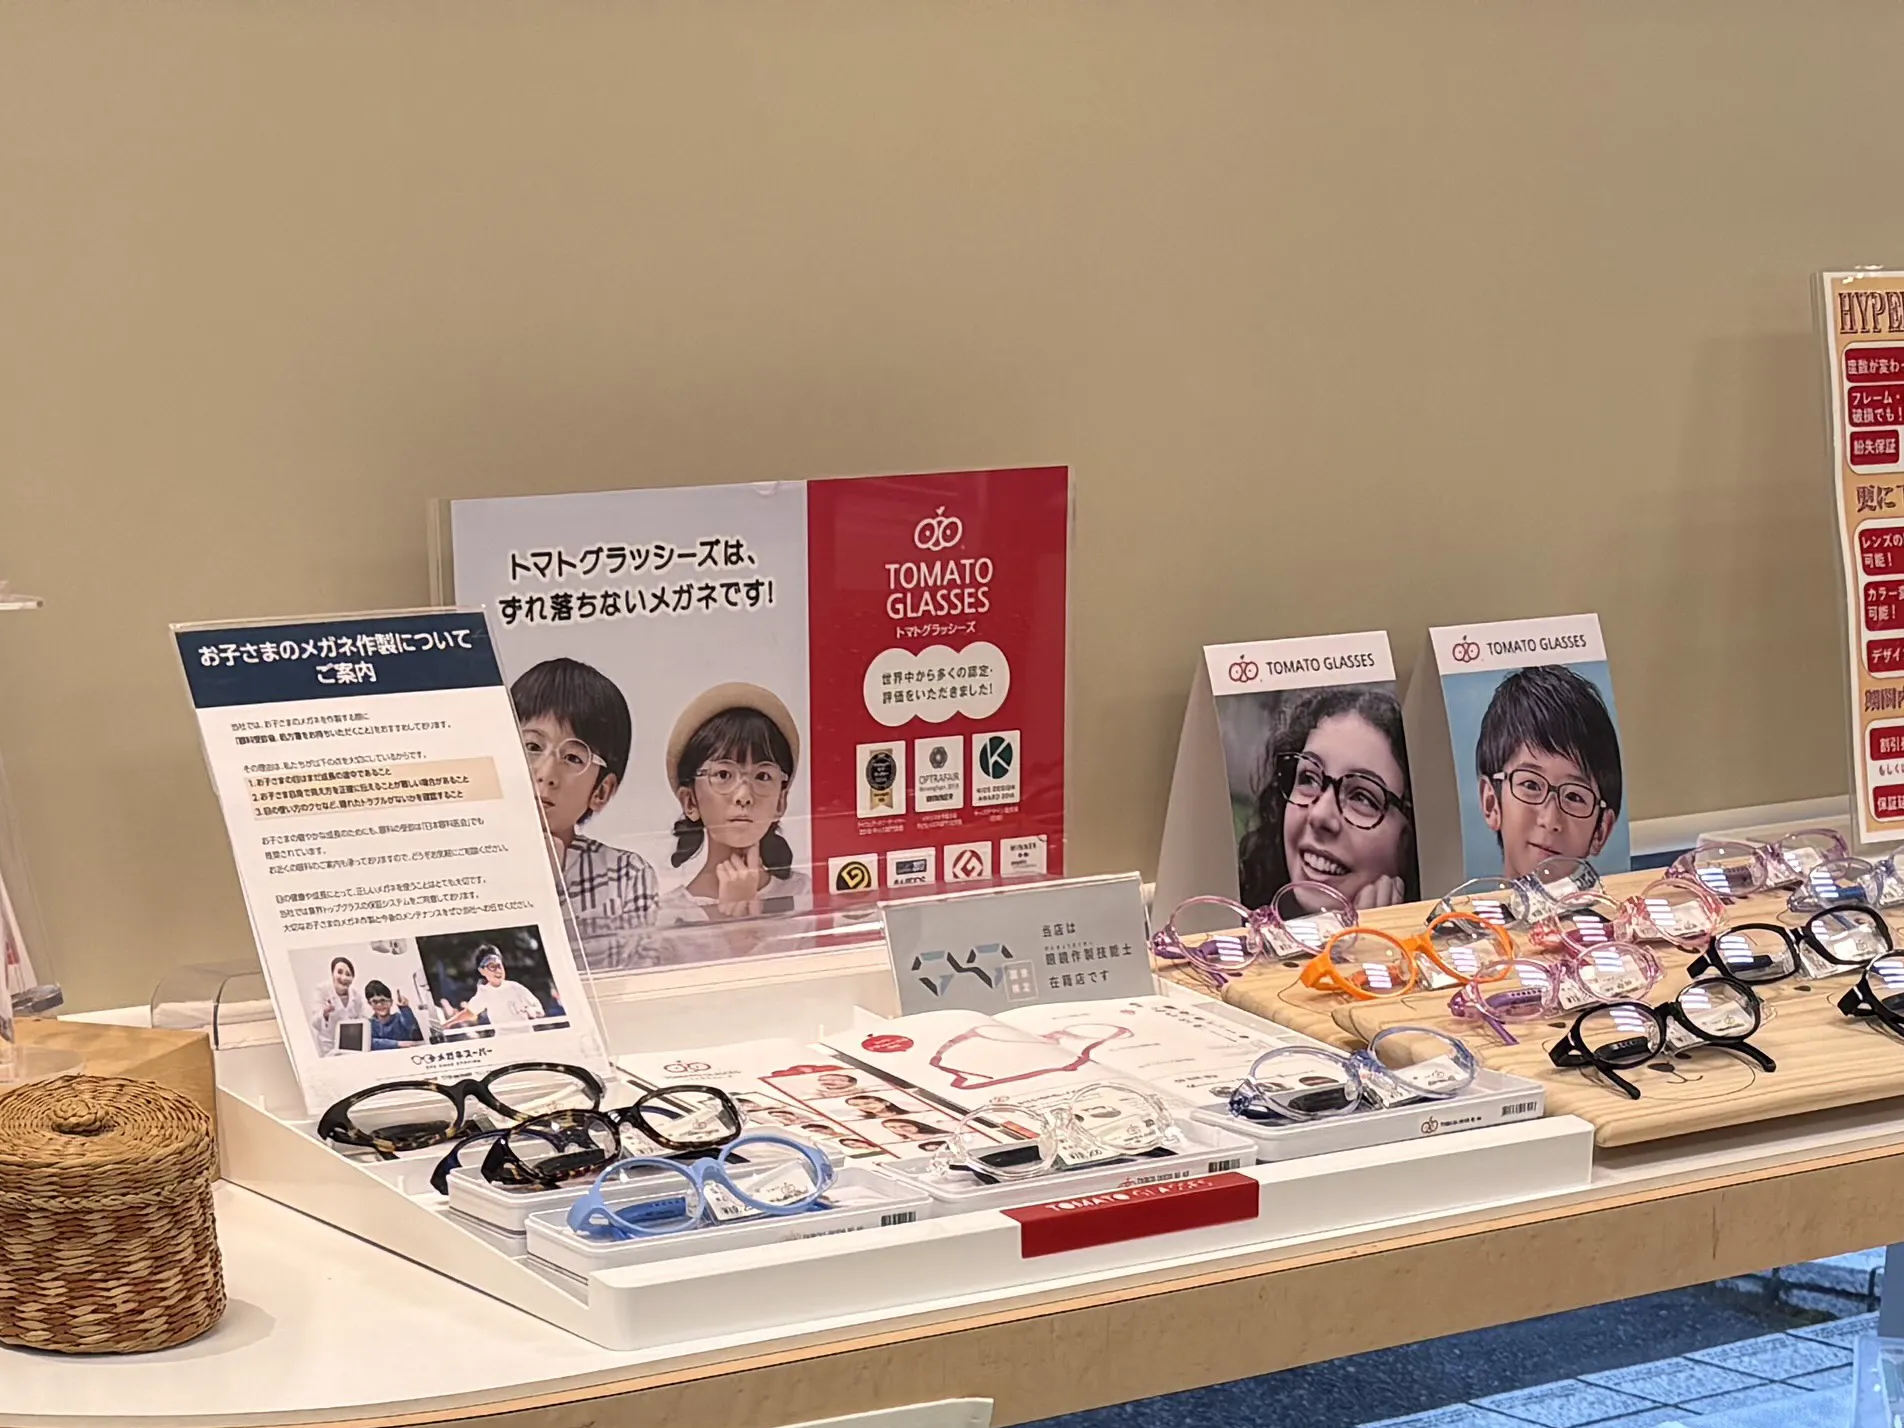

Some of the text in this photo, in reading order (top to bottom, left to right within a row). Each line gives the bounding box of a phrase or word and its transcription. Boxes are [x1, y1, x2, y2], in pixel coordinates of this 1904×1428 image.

[1852, 437, 1897, 456] 紛失保証
[510, 537, 757, 581] トマトグラッシーズは、
[884, 556, 994, 590] TOMATO
[498, 579, 774, 626] ずれ落ちないメガネです!
[886, 586, 991, 620] GLASSES
[896, 620, 977, 639] トマトグラッシーズ
[198, 628, 474, 668] お子さまのメガネ作製について
[1486, 634, 1587, 656] TOMATO GLASSES
[315, 661, 378, 686] ご案内
[1265, 652, 1376, 676] TOMATO GLASSES
[882, 683, 993, 705] 評価をいただきました!
[1042, 921, 1076, 938] 当店は
[1045, 943, 1133, 966] 眼鏡作製技能士
[1049, 969, 1111, 989] 在籍店です
[437, 1047, 494, 1063] メガネスーパー
[1045, 1192, 1131, 1212] TOMATO
